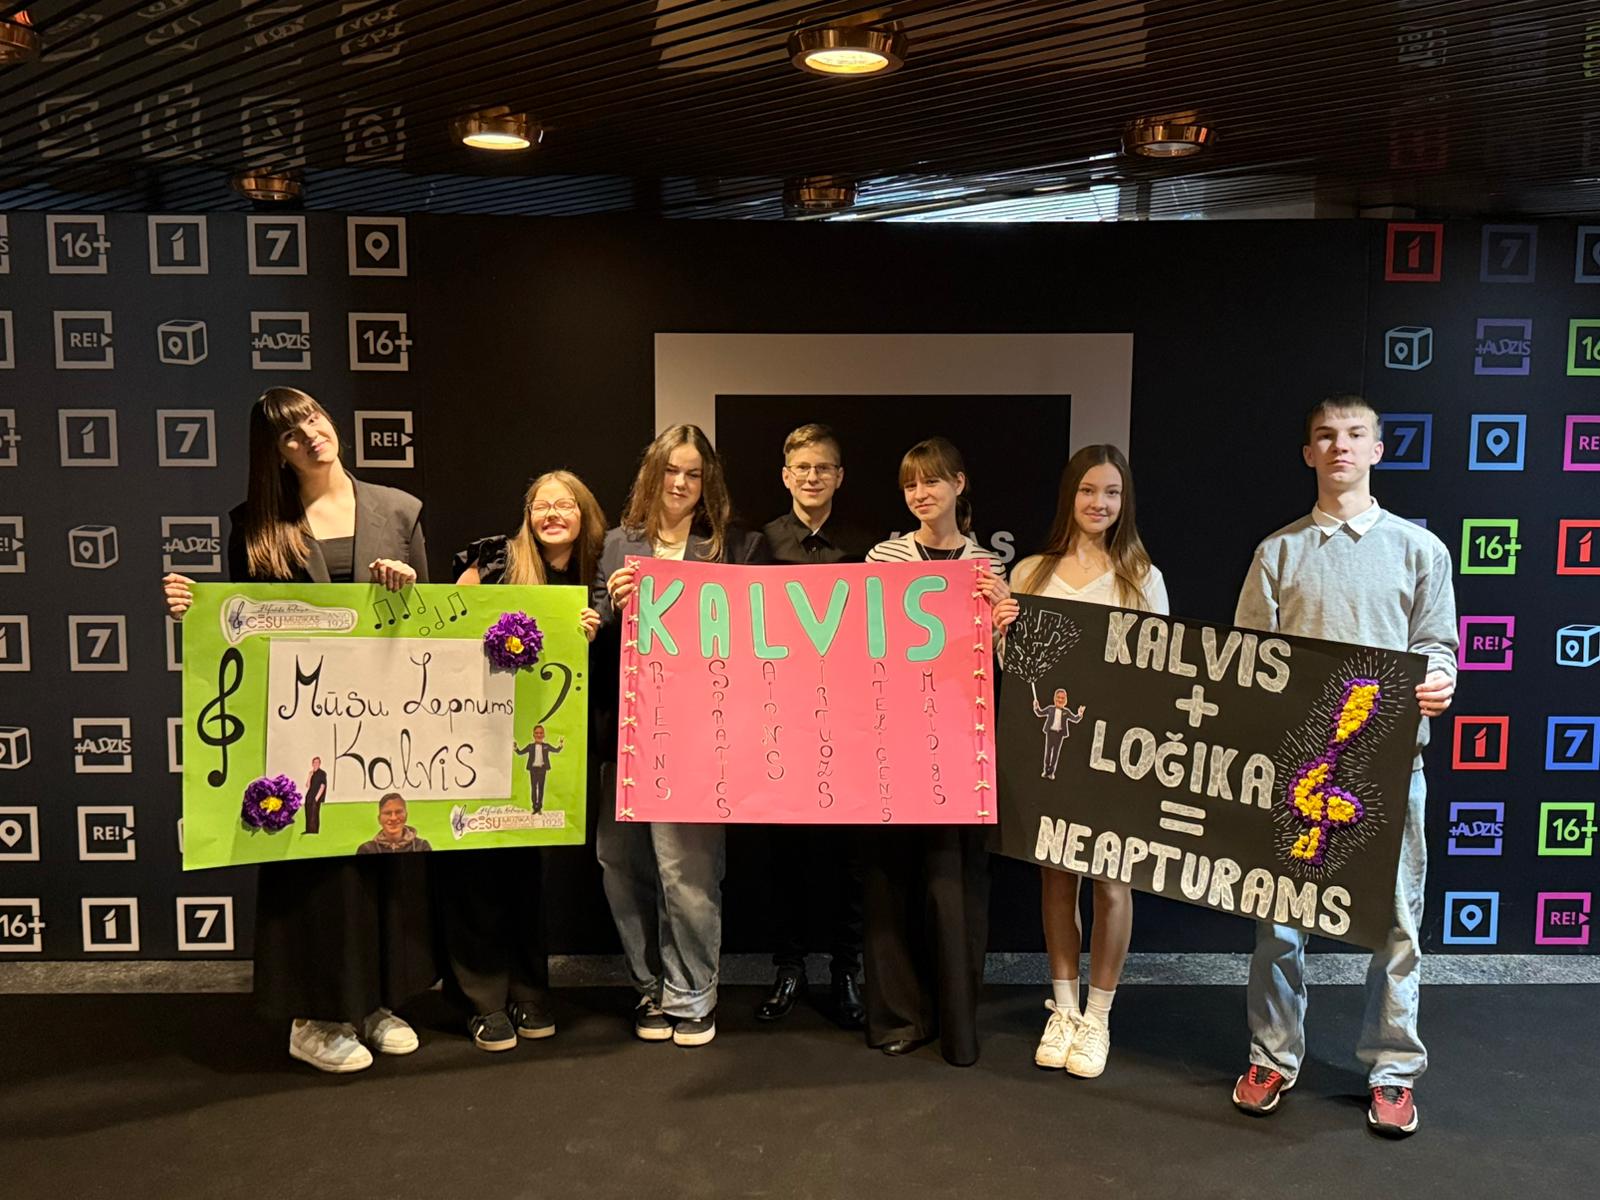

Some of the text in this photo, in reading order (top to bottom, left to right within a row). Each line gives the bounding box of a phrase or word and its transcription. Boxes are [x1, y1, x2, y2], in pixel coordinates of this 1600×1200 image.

[62, 232, 111, 258] 16+
[266, 230, 291, 261] 7
[363, 330, 412, 355] 16+
[175, 423, 200, 453] 7
[1393, 427, 1418, 456] 7
[1578, 435, 1600, 450] RE
[1475, 535, 1522, 560] 16+
[636, 574, 948, 662] KALVIS
[87, 629, 112, 658] 7
[1103, 611, 1292, 693] KALVIS
[278, 654, 389, 720] Mūsu
[1563, 729, 1588, 757] 7
[1552, 818, 1598, 841] 16+
[1034, 815, 1352, 936] NEAPTURAMS
[194, 909, 219, 938] 7
